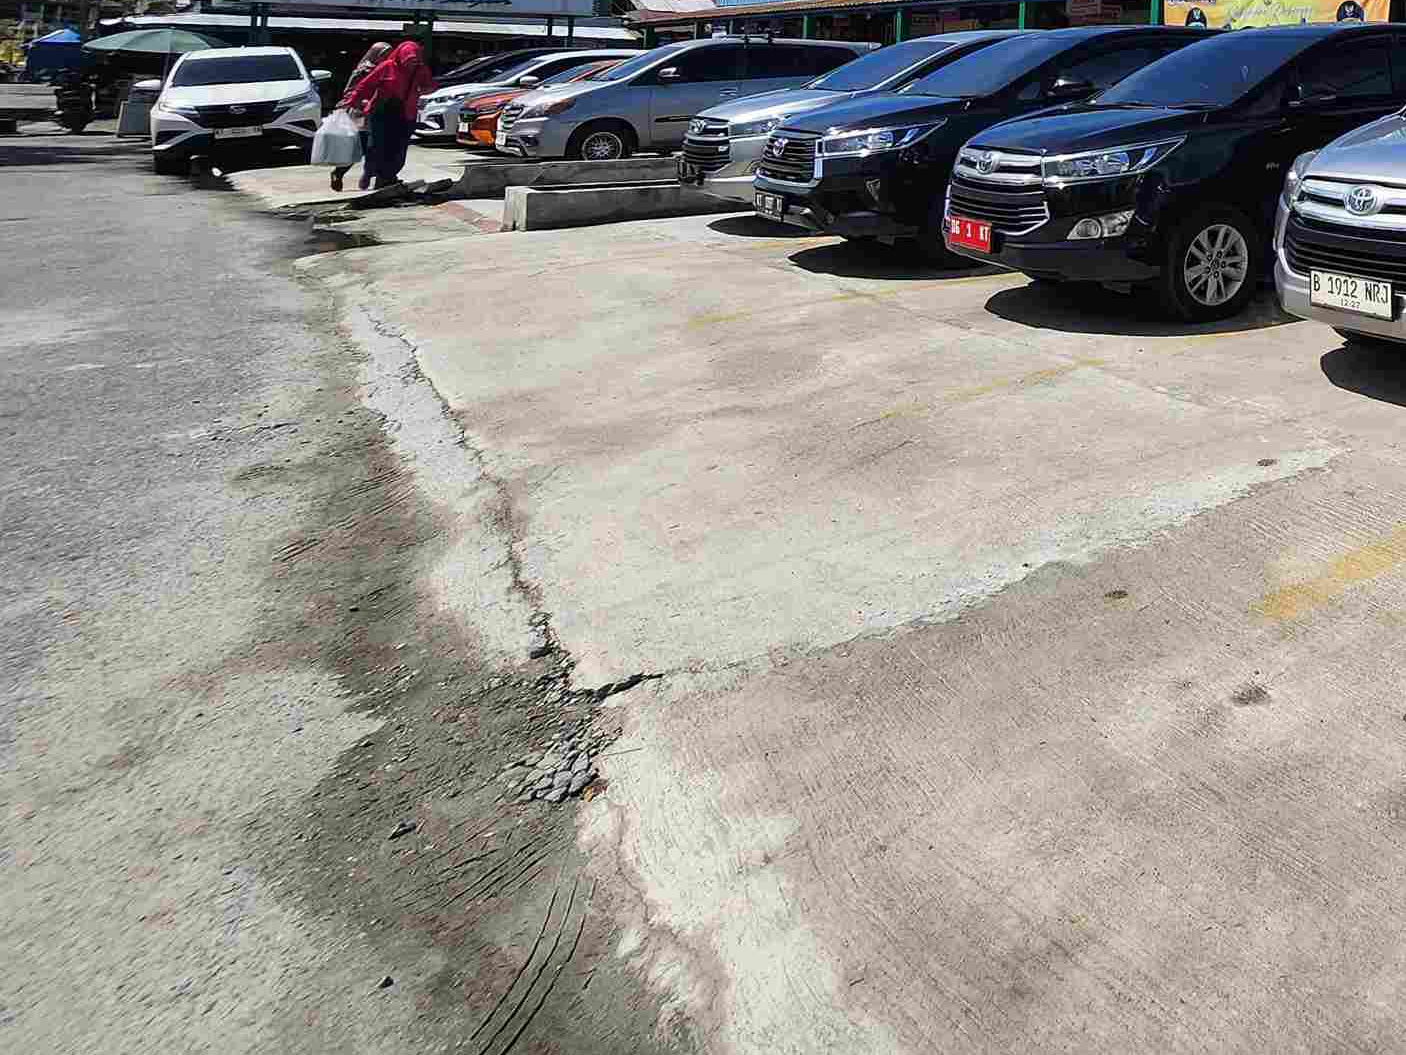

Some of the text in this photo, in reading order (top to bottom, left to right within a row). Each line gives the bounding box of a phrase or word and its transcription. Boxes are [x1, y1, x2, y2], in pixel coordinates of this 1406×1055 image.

[1313, 273, 1389, 304] B 1912 NRJ
